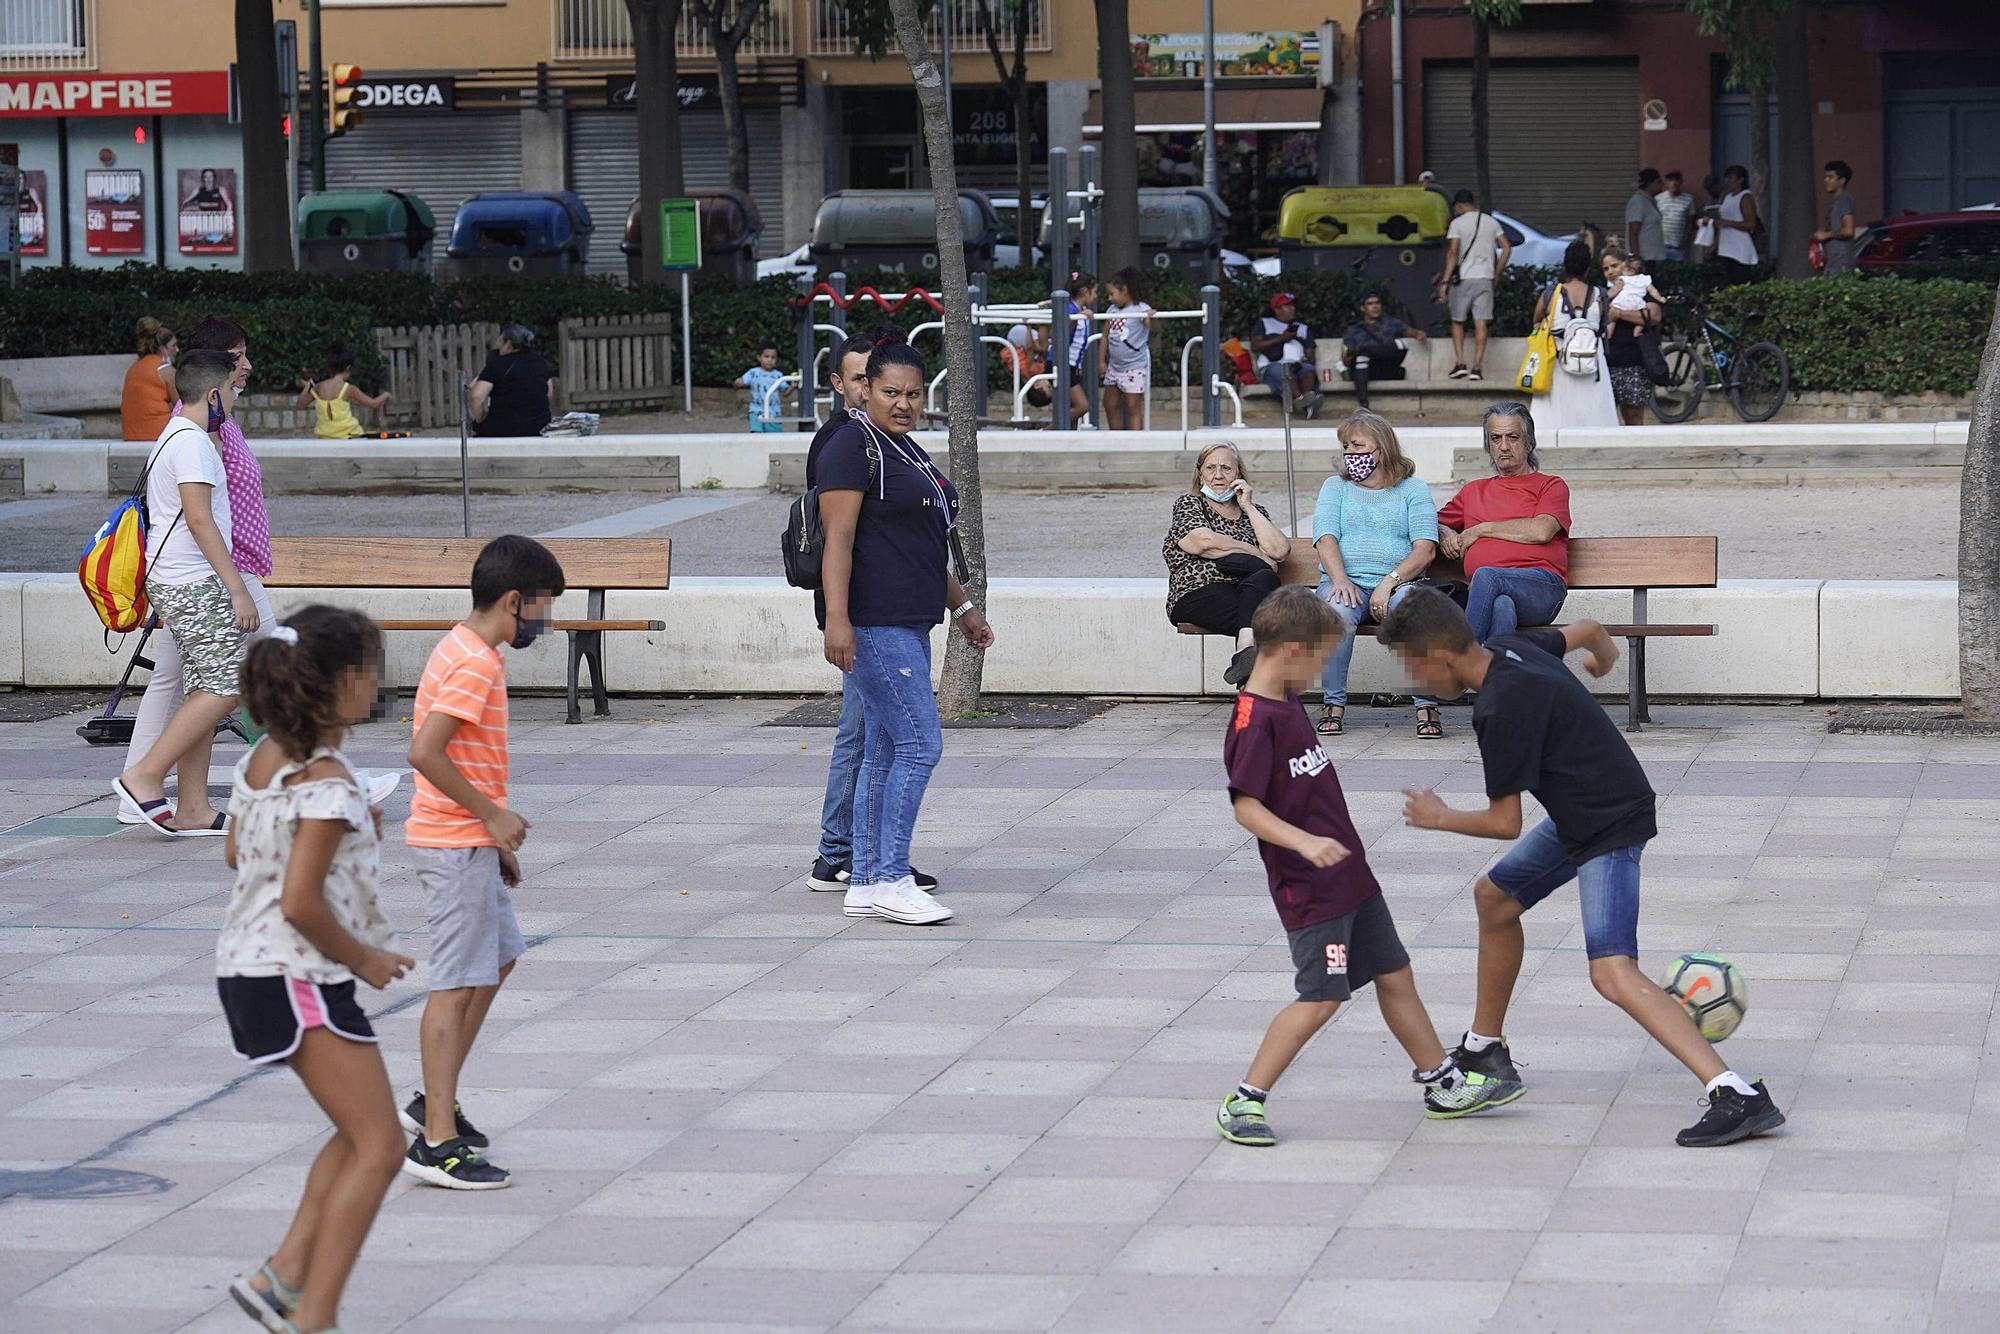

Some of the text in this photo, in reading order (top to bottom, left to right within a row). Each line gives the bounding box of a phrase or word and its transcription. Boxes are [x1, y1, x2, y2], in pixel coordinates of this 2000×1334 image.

[0, 79, 173, 111] MAPFRE
[355, 83, 444, 107] ODEGA
[969, 111, 1008, 130] 208
[982, 132, 1039, 144] EUGEA
[1325, 943, 1347, 967] 96
